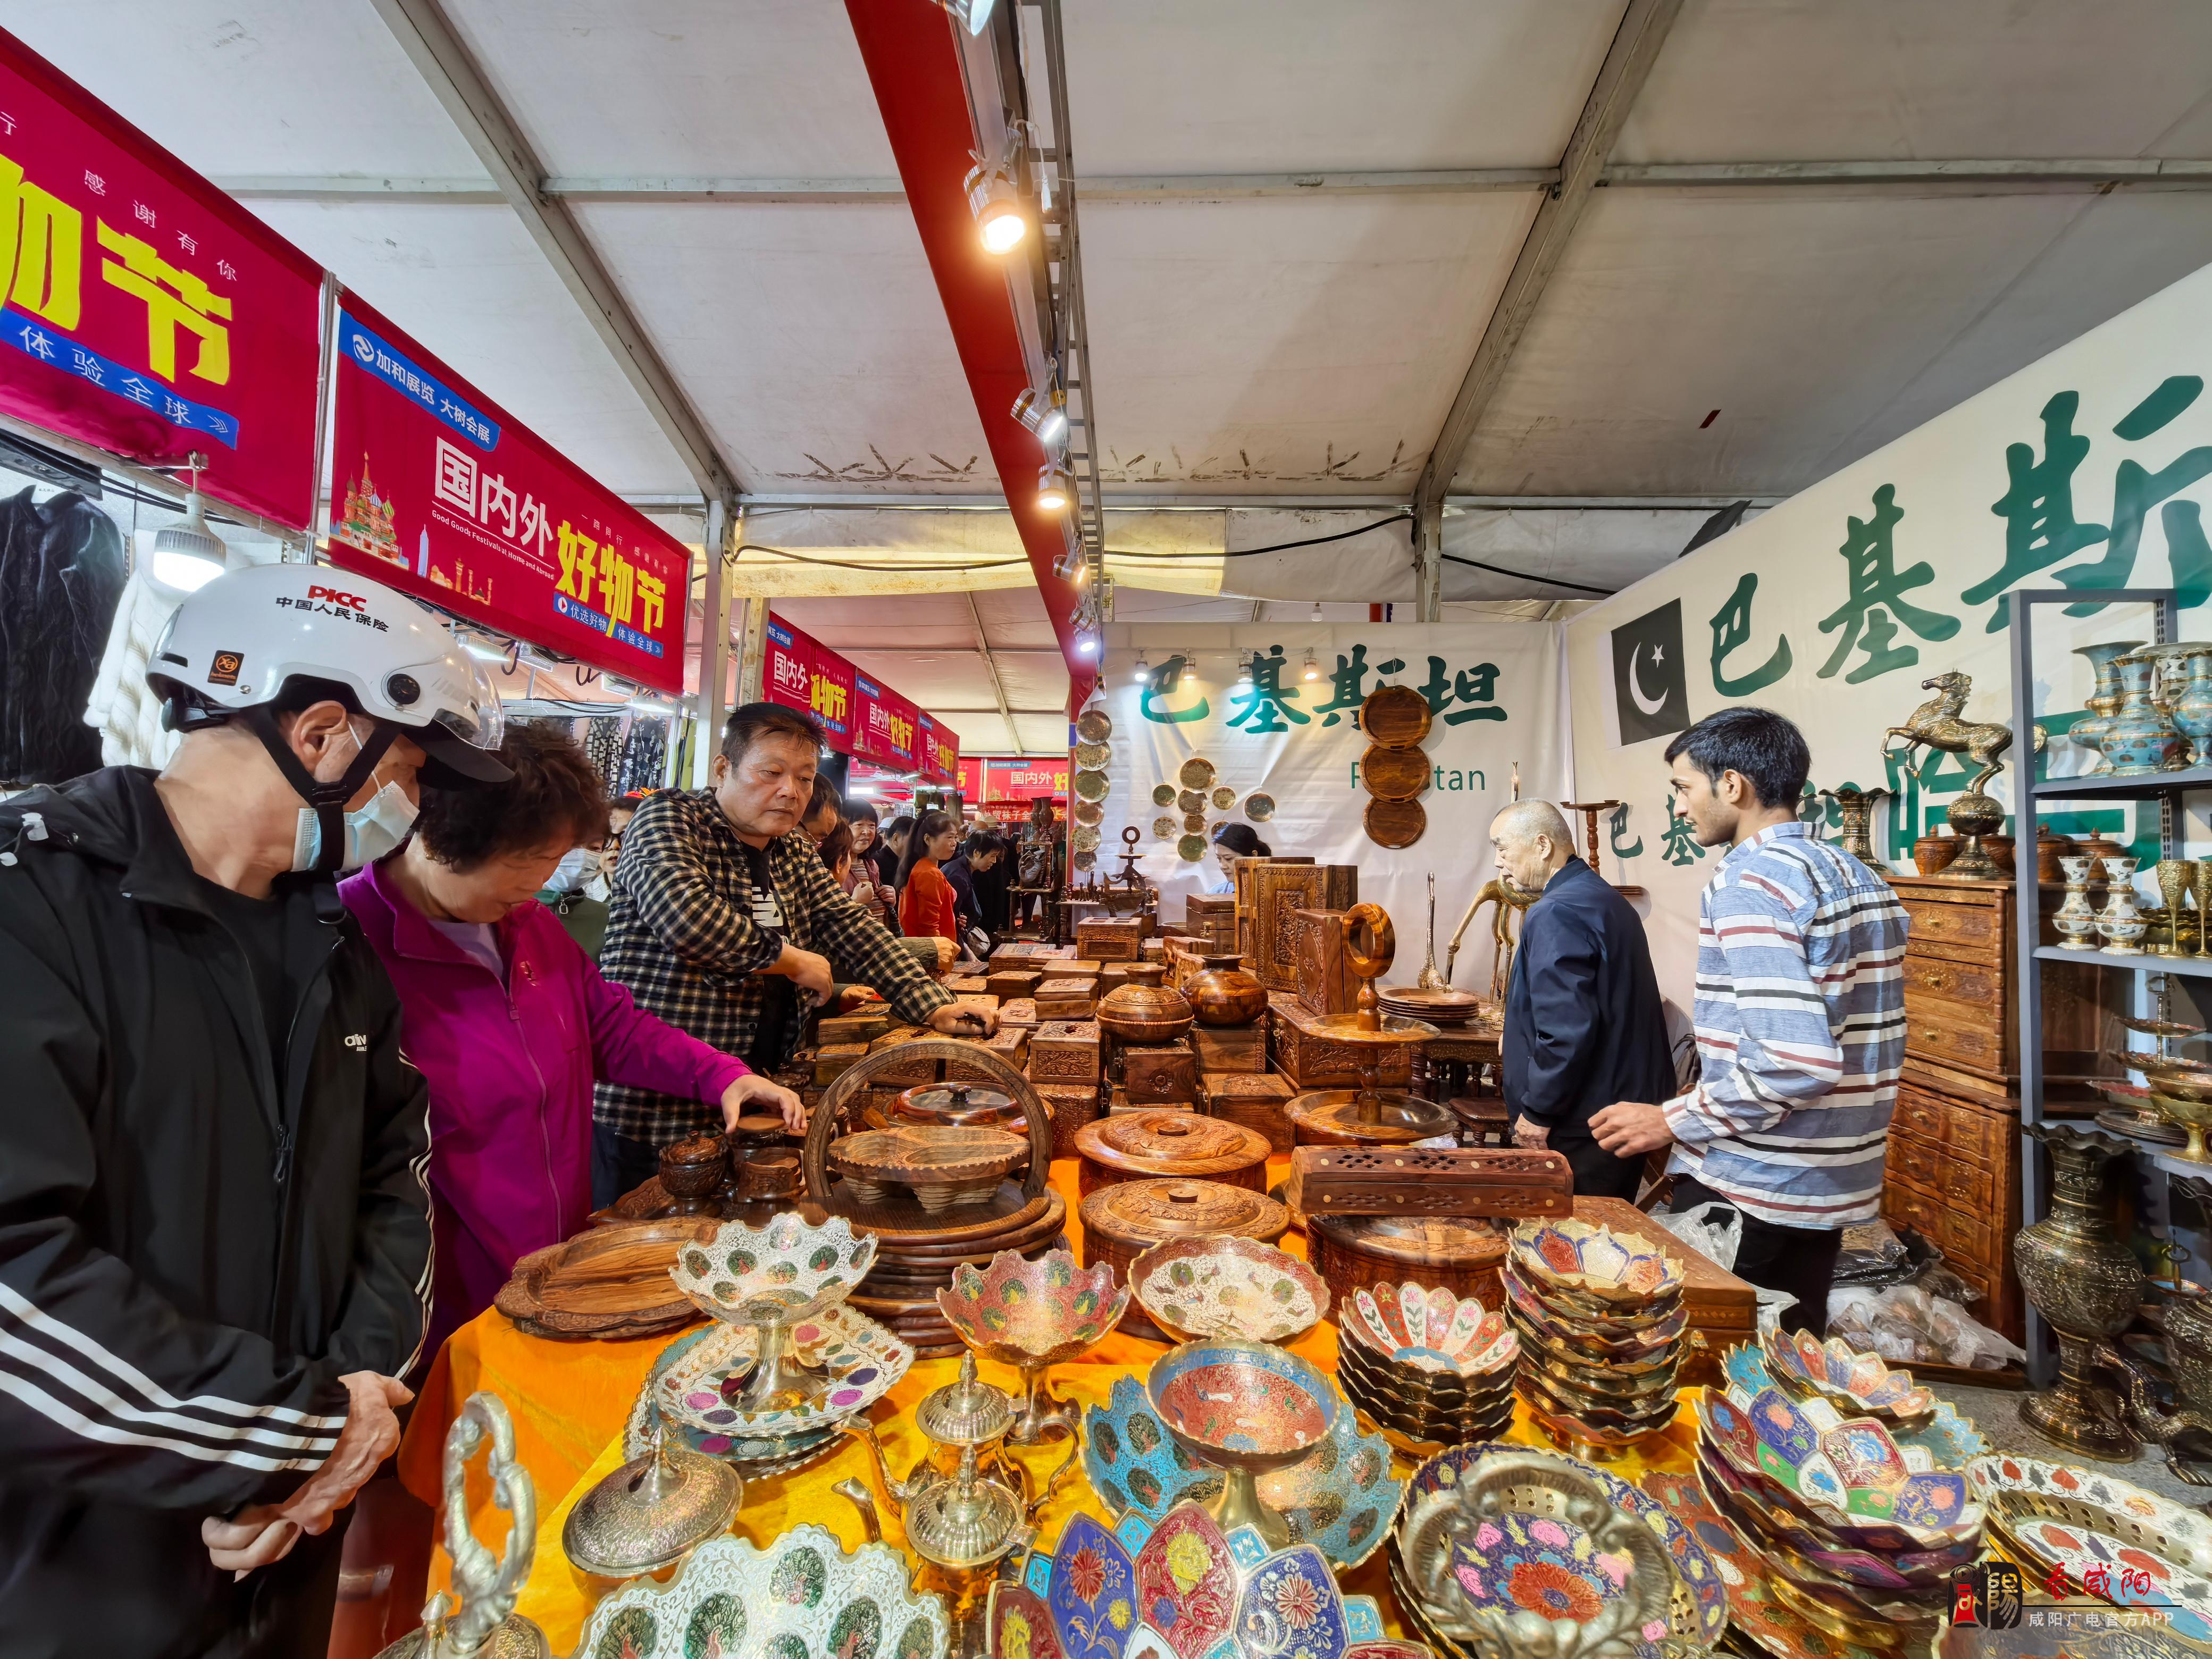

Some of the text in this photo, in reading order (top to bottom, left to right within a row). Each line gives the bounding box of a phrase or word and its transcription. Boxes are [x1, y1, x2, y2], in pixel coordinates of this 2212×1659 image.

[85, 170, 237, 281] 感谢有你
[19, 325, 191, 424] 体验全球
[376, 349, 490, 445] 加和展览 大树会展
[435, 436, 554, 557] 国内外
[432, 509, 449, 525] Good
[451, 520, 471, 537] Goods
[472, 532, 501, 552] Festivals
[508, 551, 525, 564] Home
[525, 560, 536, 571] and
[536, 565, 554, 580] Abroad
[557, 520, 666, 638] 好物节
[276, 597, 389, 632] 中国人民保险
[307, 585, 367, 612] PICC
[571, 604, 652, 653] 优选好物 体验全球
[1139, 644, 1508, 734] 巴基斯坦
[1010, 771, 1052, 785] 国内外
